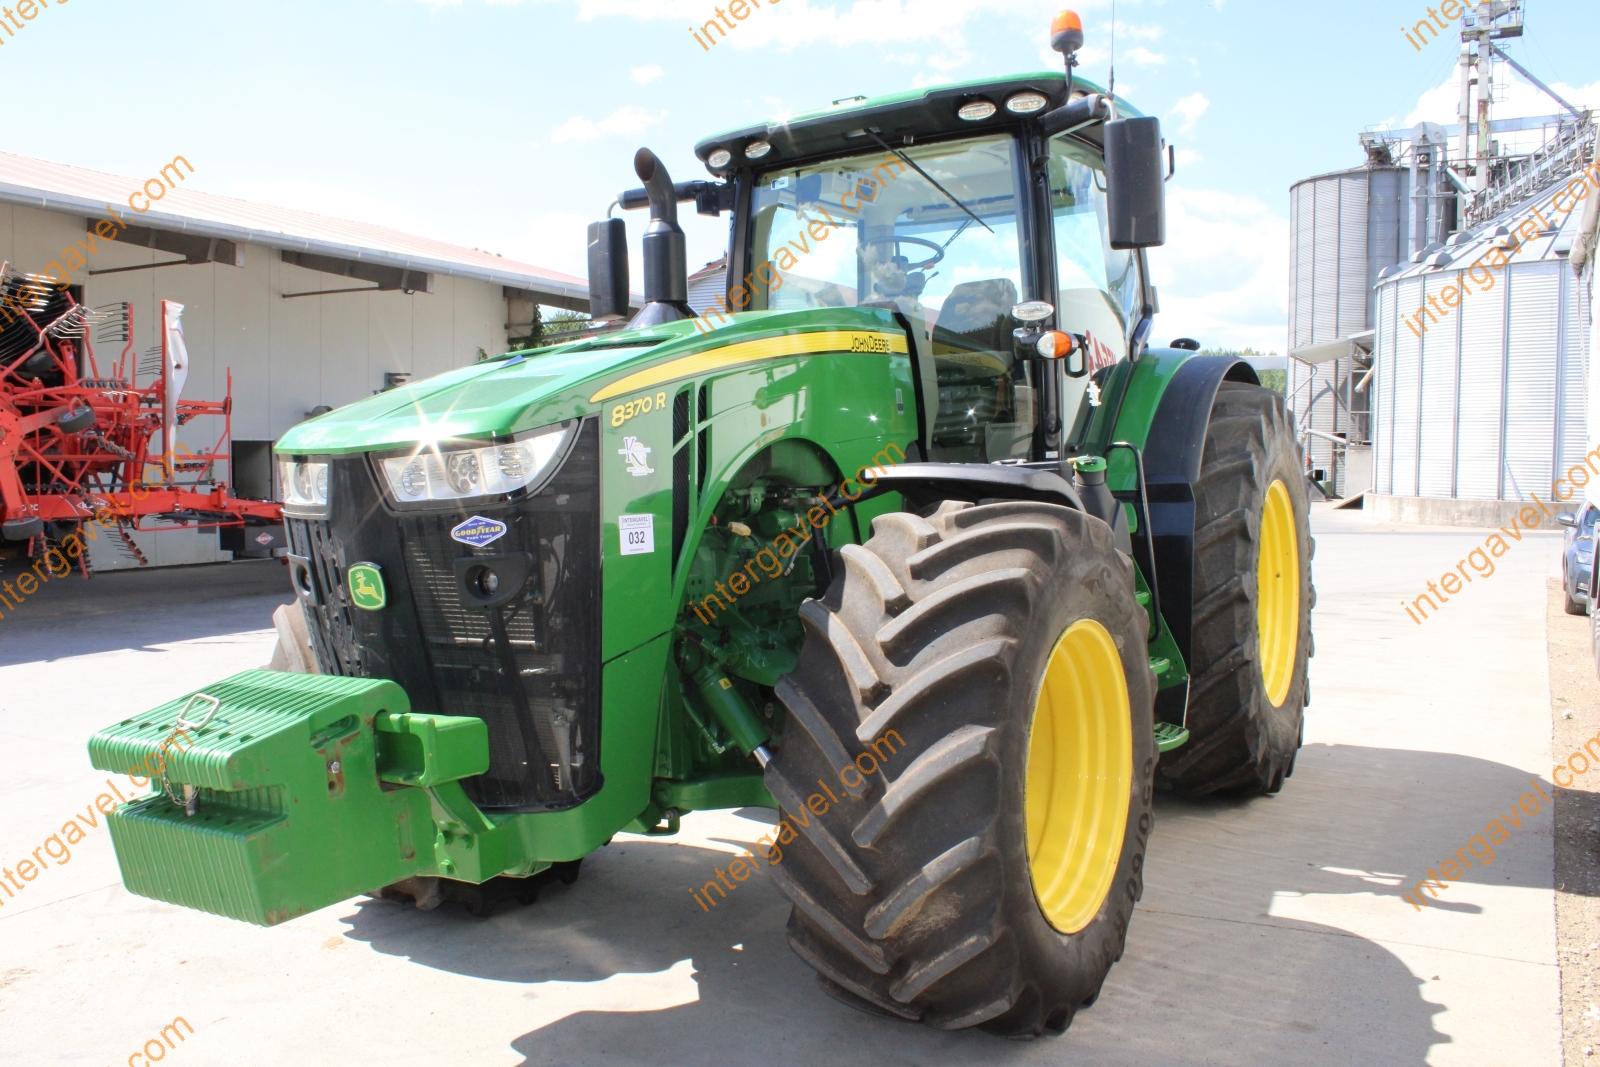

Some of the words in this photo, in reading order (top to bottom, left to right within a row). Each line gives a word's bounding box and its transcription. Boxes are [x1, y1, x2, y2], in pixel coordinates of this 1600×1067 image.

[611, 396, 653, 427] 8370
[655, 391, 666, 410] R
[623, 516, 649, 524] INTERGAVEL
[455, 525, 502, 537] GOODYEAR
[628, 531, 645, 545] 032
